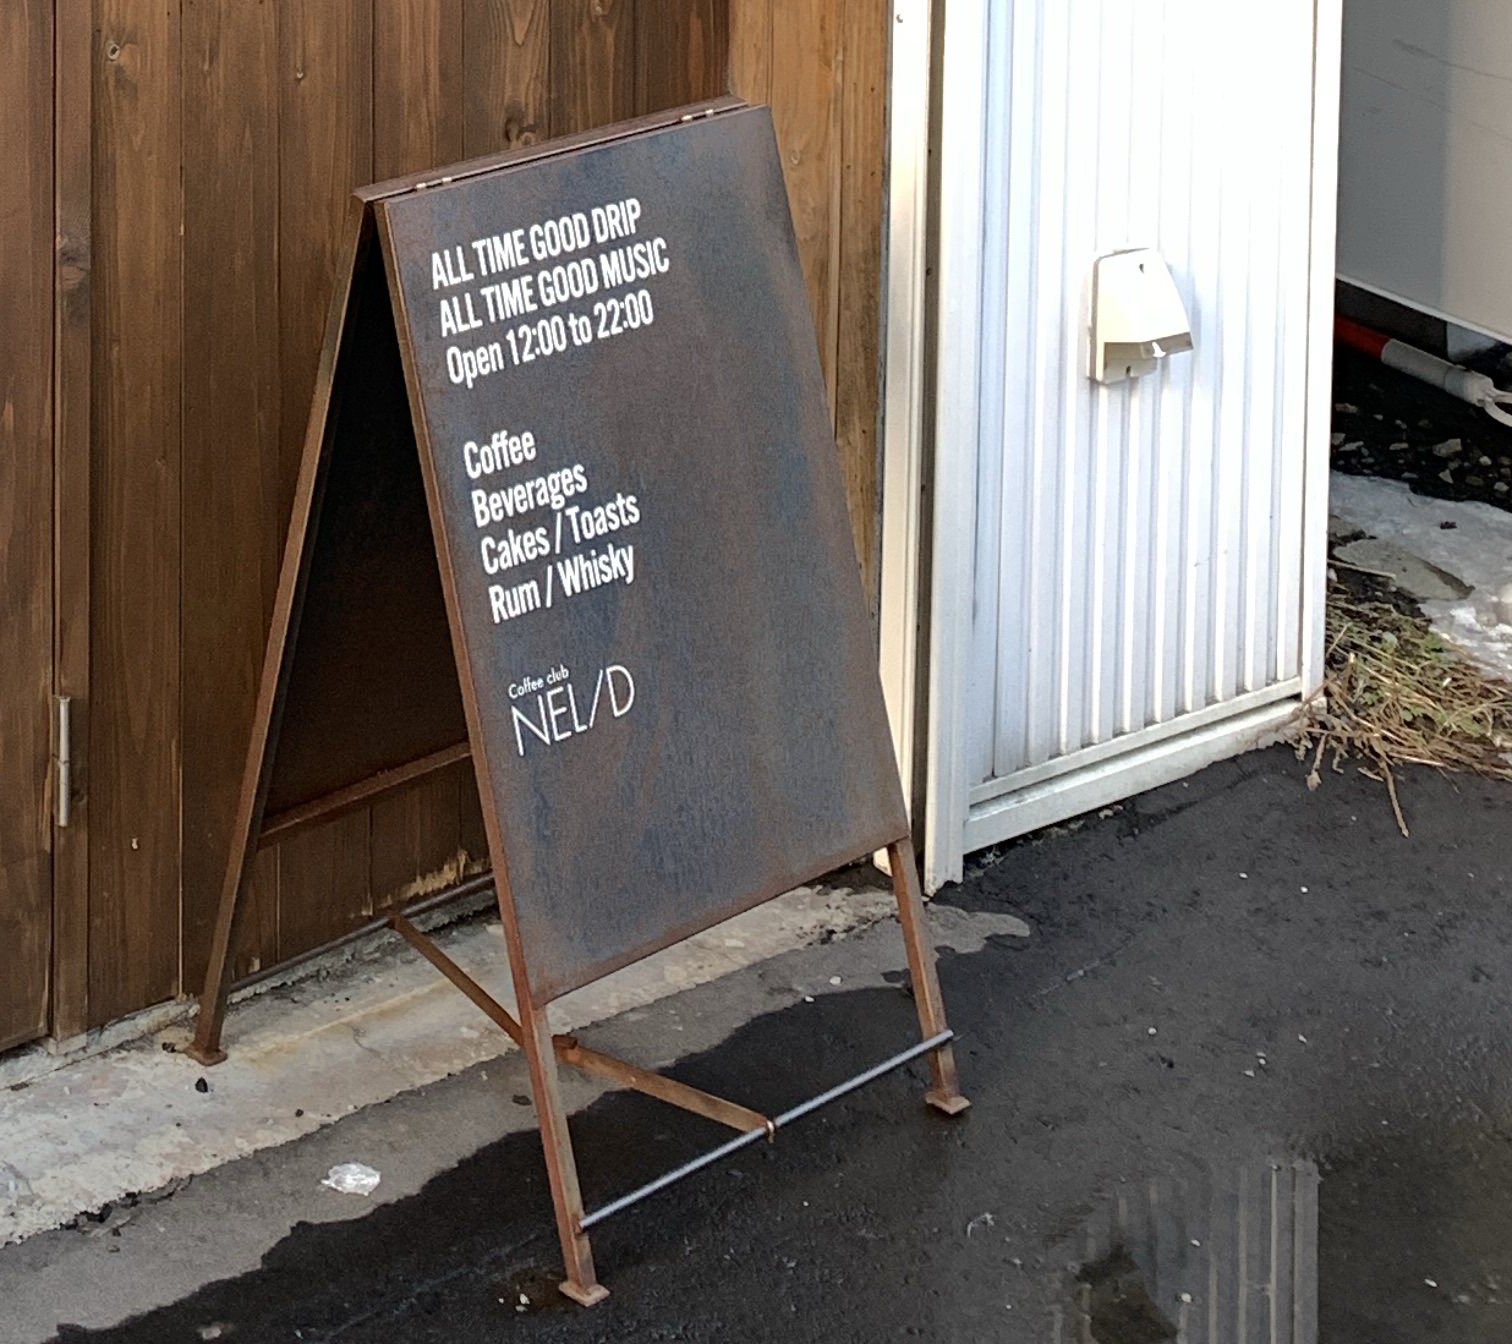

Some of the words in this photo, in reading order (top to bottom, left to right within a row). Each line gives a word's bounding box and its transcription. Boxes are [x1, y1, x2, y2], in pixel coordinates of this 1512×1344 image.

[431, 246, 475, 291] ALL
[472, 229, 530, 276] TIME
[529, 213, 591, 261] GOOD
[591, 198, 641, 243] DRIP
[440, 293, 483, 337] ALL
[481, 275, 538, 323] TIME
[538, 258, 599, 307] GOOD
[599, 237, 670, 290] MUSIC
[446, 341, 505, 389] Open
[506, 315, 567, 366] 12:00
[569, 313, 593, 346] to
[594, 289, 654, 339] 22:00
[464, 430, 537, 479] Coffee
[471, 464, 587, 528] Beverages
[481, 527, 550, 575] Cakes
[565, 493, 641, 544] Toasts
[488, 580, 541, 624] Rum
[557, 543, 634, 598] Whisky
[508, 675, 544, 700] Coffee
[546, 664, 569, 685] club
[511, 665, 635, 757] NEL/D
